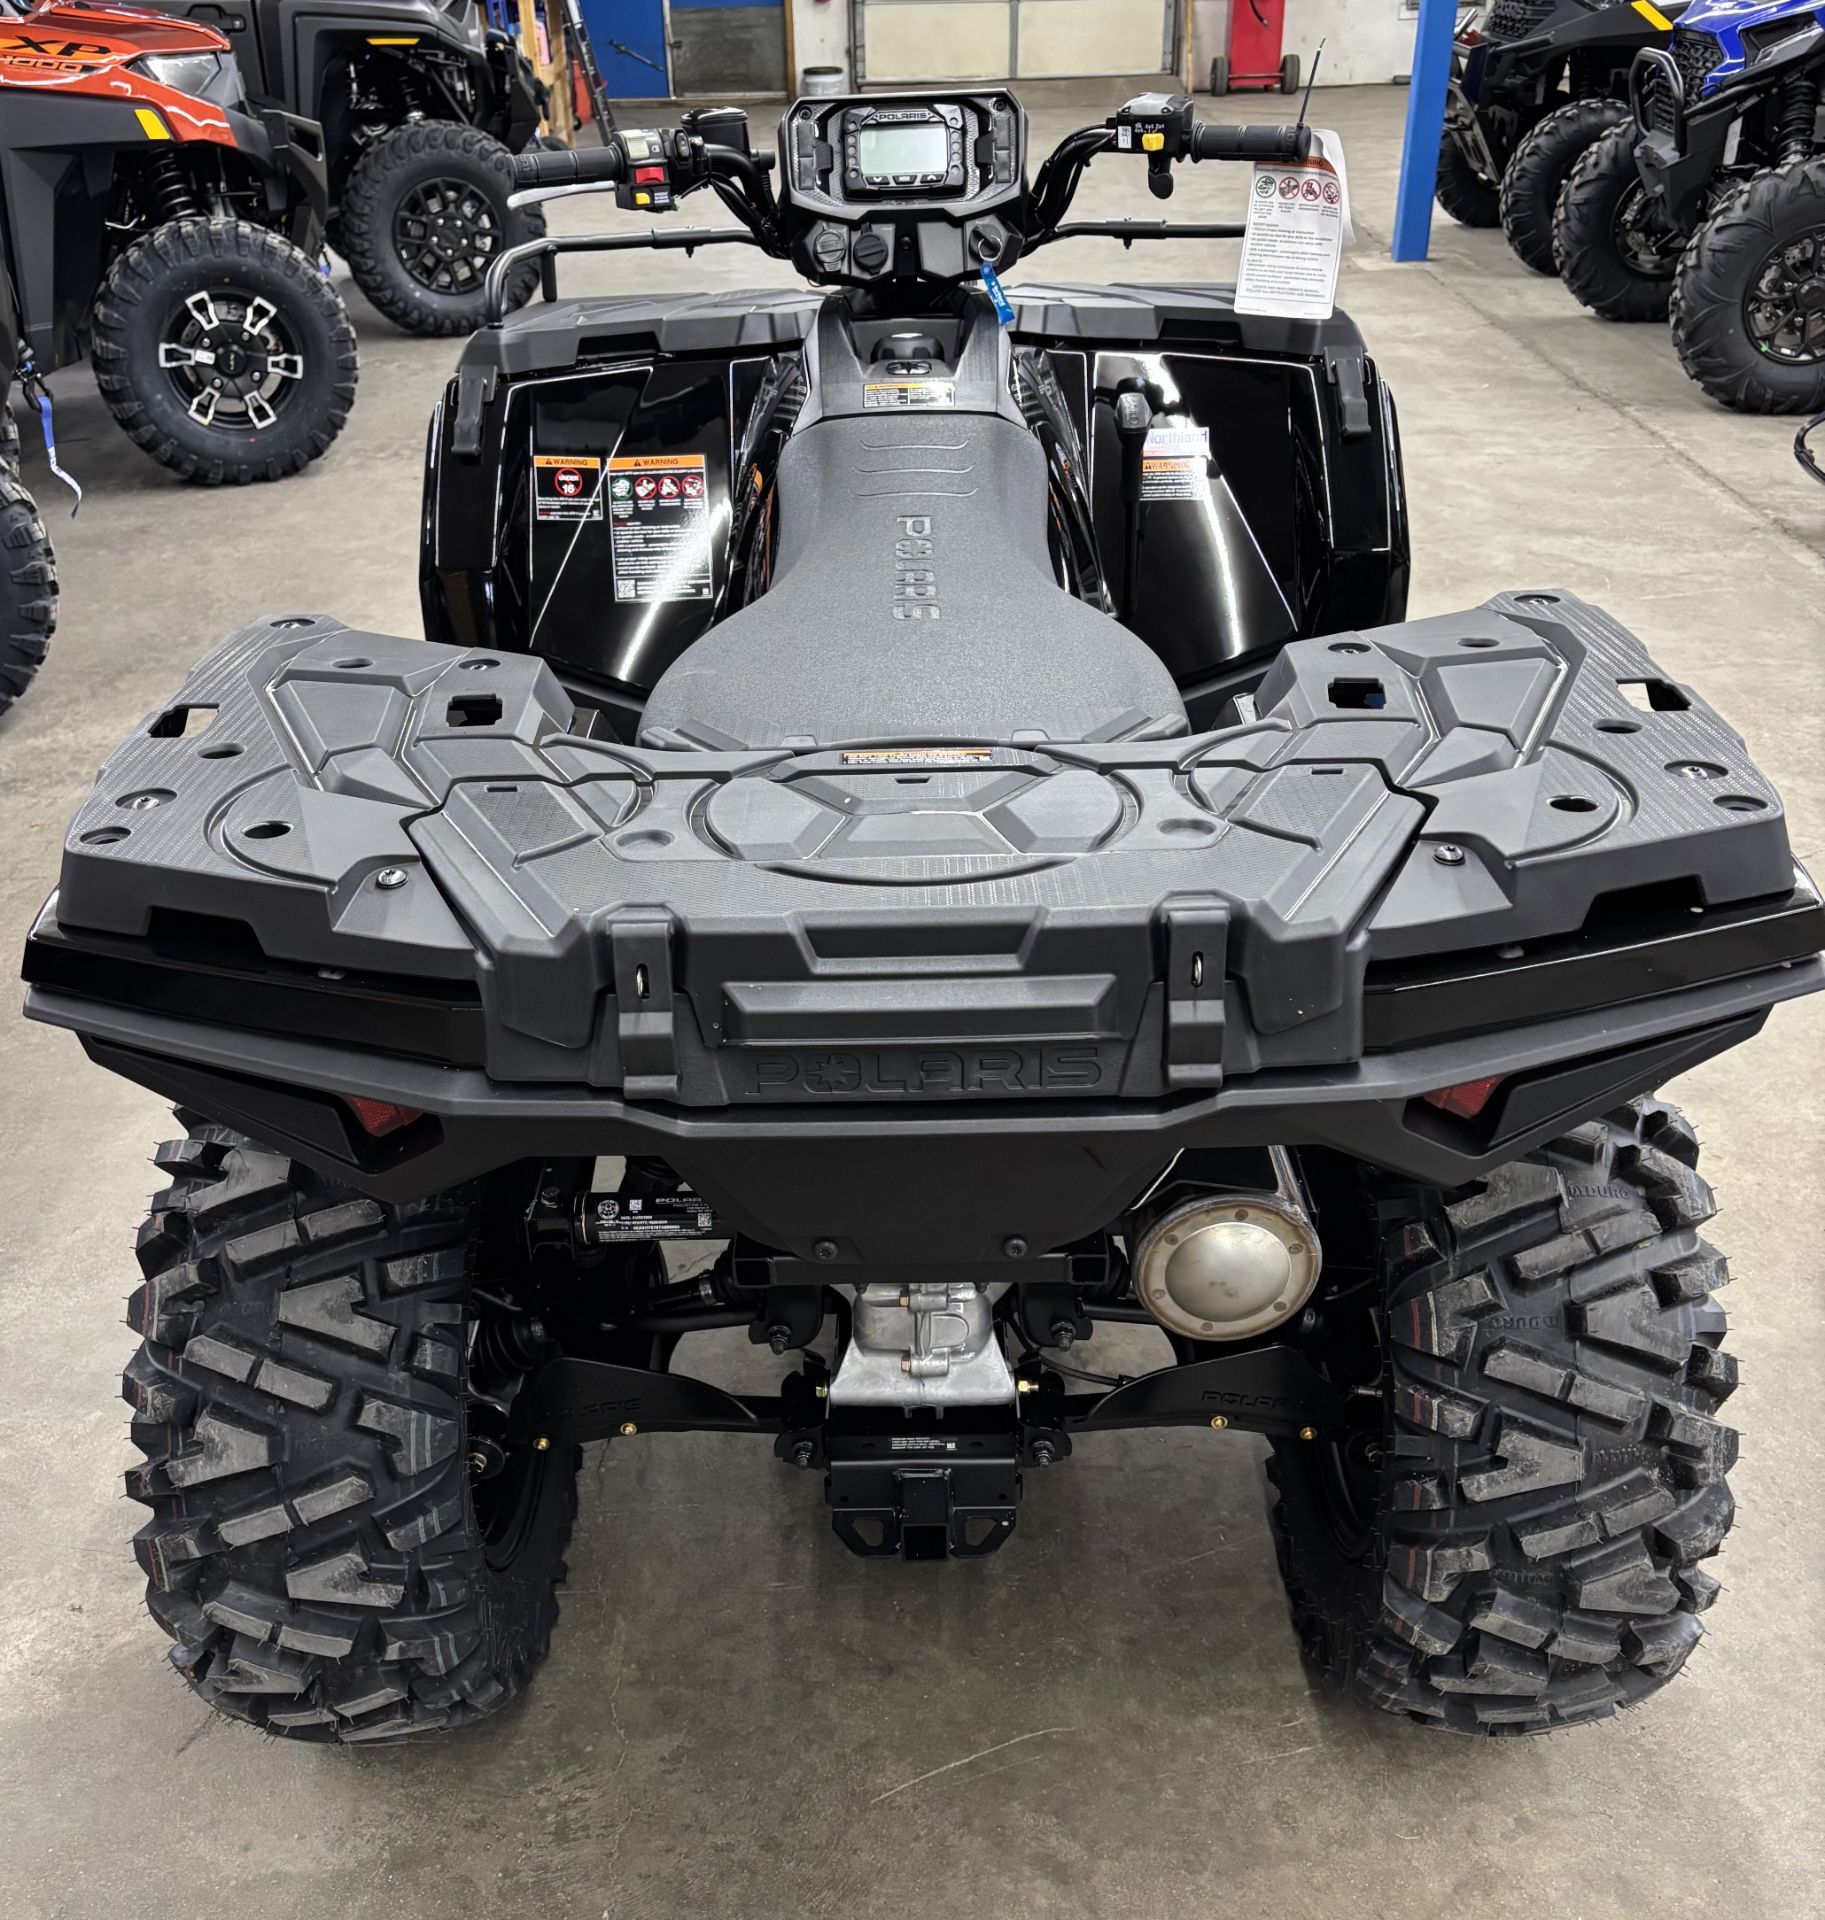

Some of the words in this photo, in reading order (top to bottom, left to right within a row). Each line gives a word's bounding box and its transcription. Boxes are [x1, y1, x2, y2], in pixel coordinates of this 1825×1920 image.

[2, 35, 112, 56] XP
[878, 112, 927, 120] POLARIS
[642, 458, 679, 466] WARNING
[562, 483, 576, 494] 16
[892, 514, 940, 621] POLARIS
[744, 1047, 1102, 1095] POLARIS
